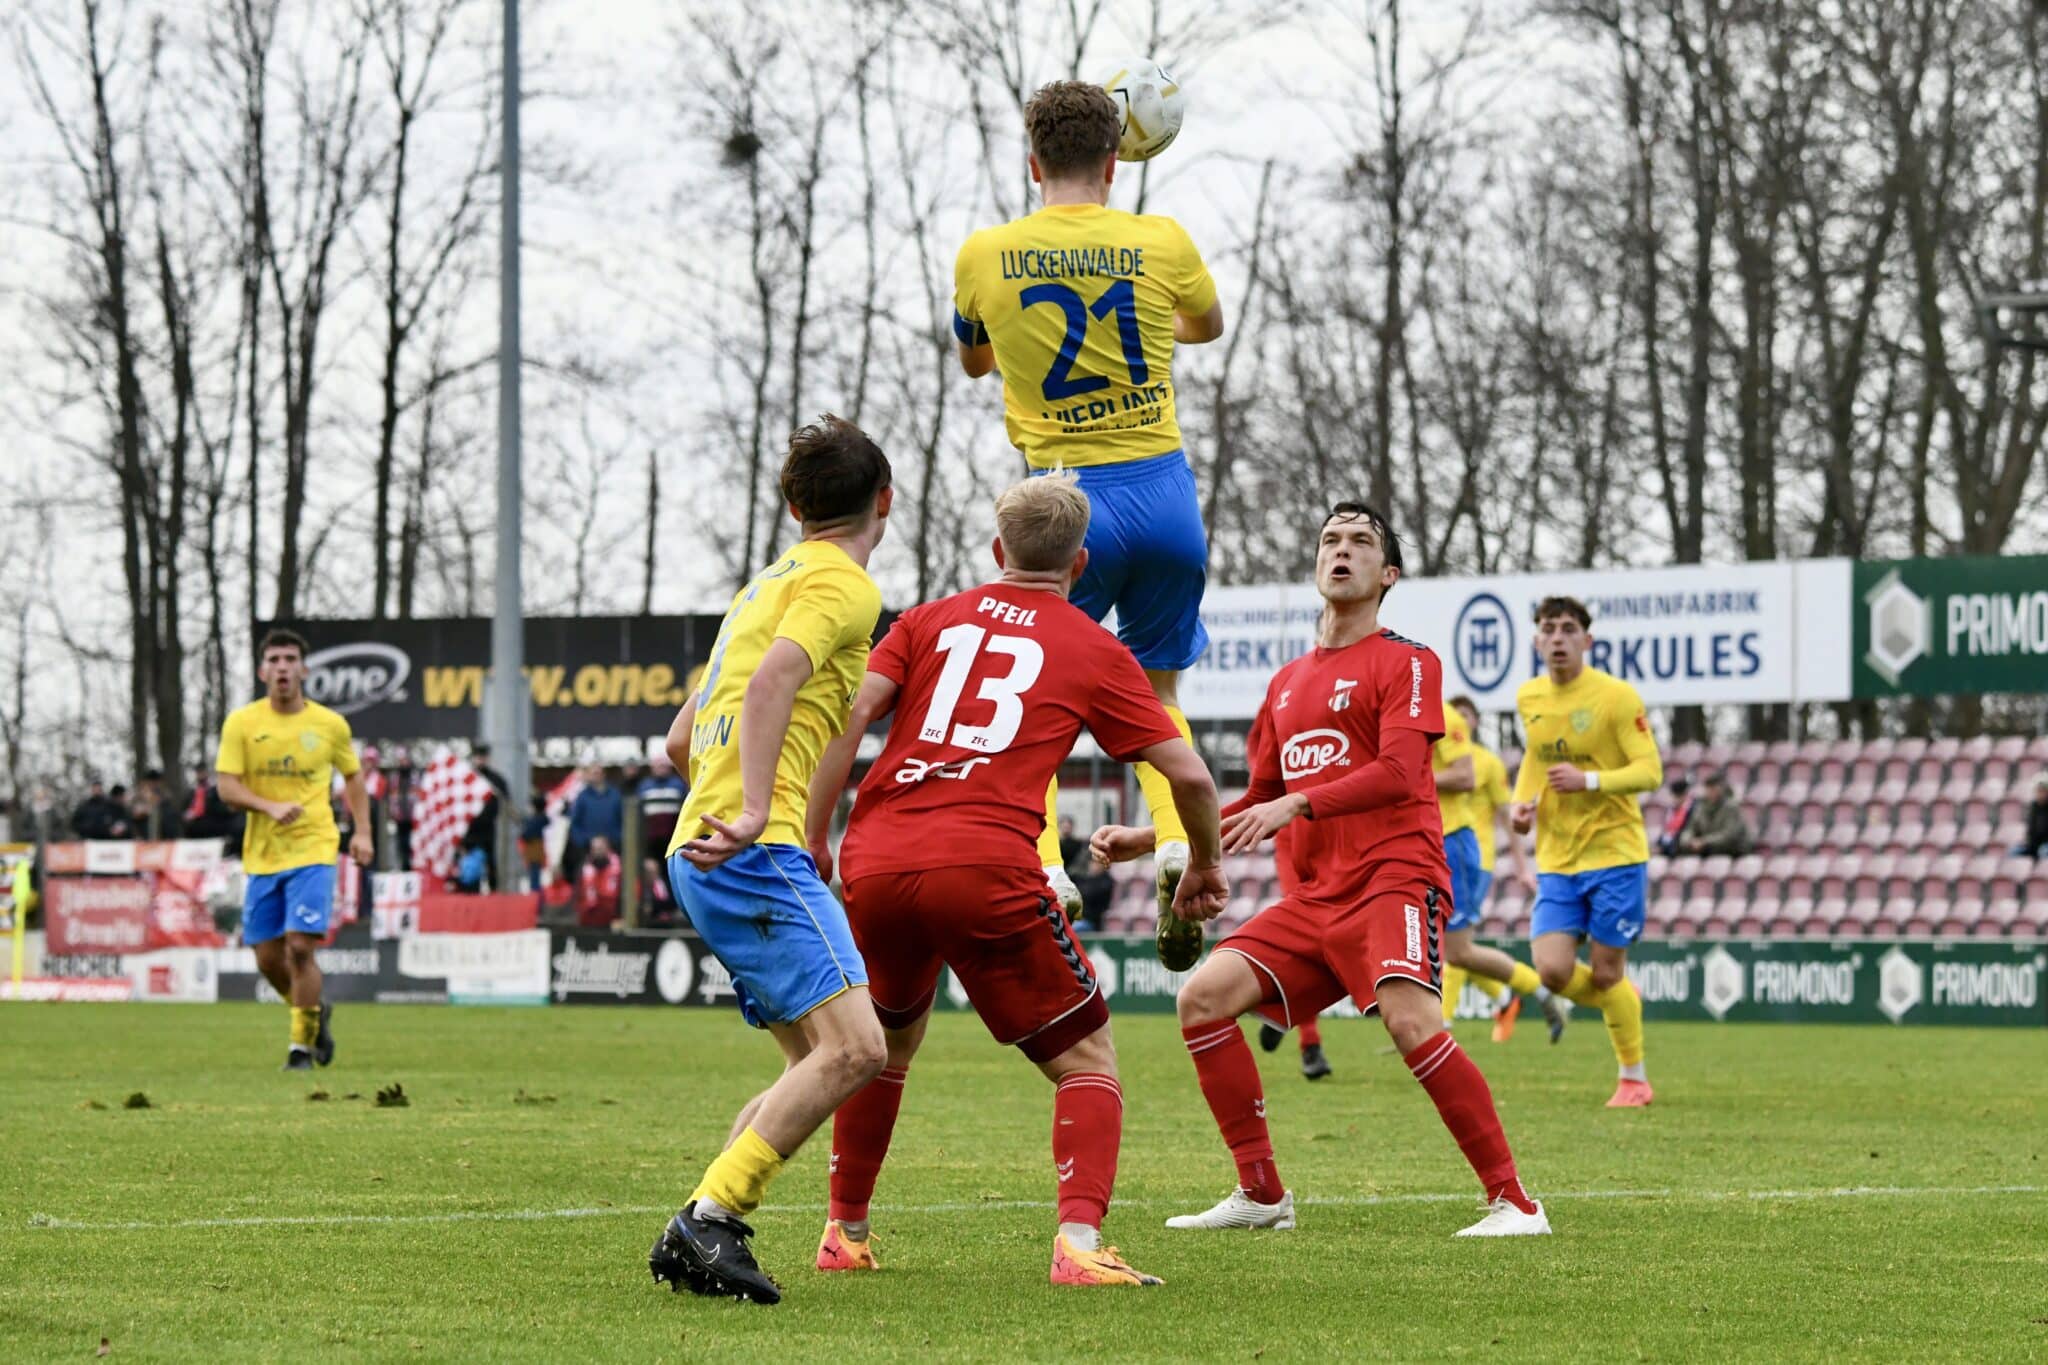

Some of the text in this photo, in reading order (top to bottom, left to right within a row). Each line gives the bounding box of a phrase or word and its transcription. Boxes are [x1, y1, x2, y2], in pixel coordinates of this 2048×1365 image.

[1001, 248, 1145, 280] LUCKENWALDE
[1019, 280, 1149, 401] 21
[977, 597, 1037, 627] PFEIL
[1531, 631, 1761, 680] HRKULES
[304, 666, 387, 702] one
[917, 623, 1044, 753] 13
[924, 727, 942, 739] ZFC
[970, 735, 989, 747] ZFC
[1624, 961, 1690, 1002] MONO
